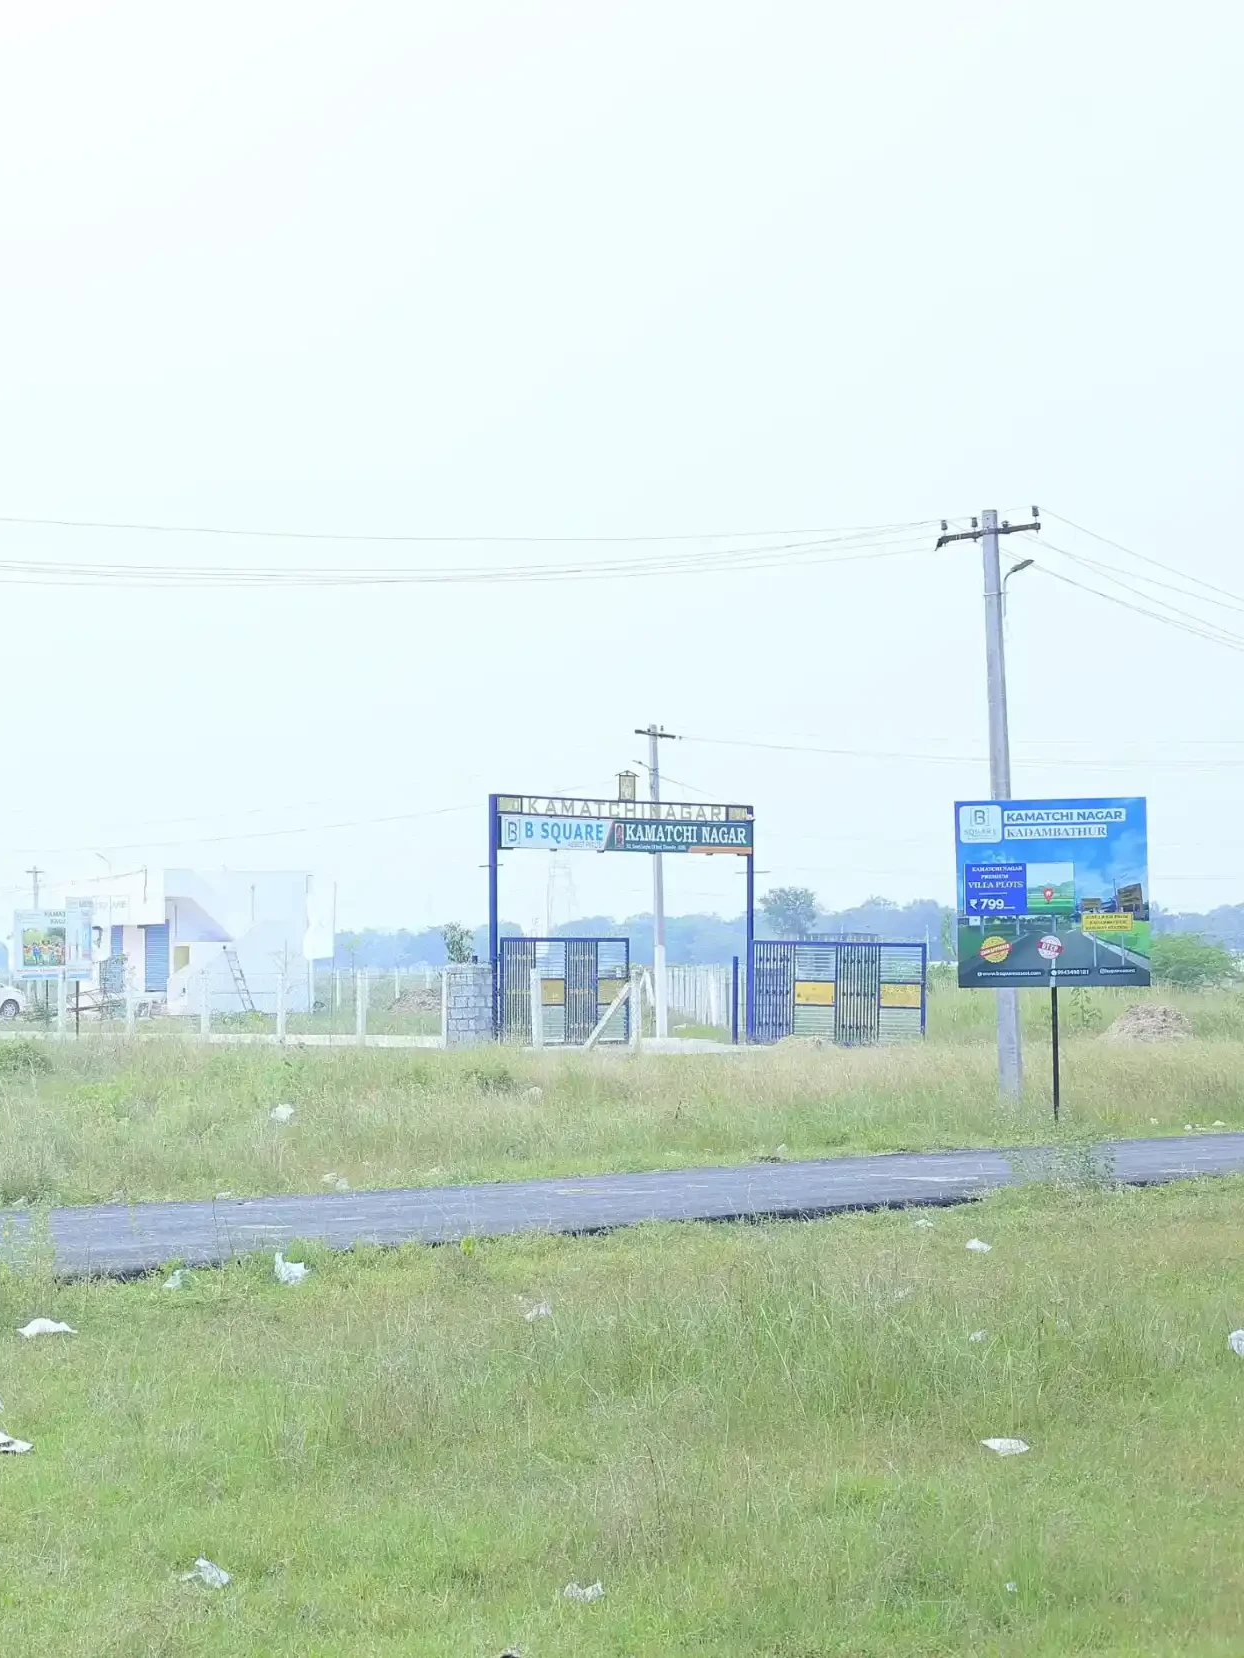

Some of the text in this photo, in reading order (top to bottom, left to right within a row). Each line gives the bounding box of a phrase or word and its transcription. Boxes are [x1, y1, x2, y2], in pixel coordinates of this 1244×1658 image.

[1006, 810, 1123, 823] KAMATCHI NAGAR
[524, 822, 604, 844] B SQUARE
[625, 823, 747, 844] KAMATCHI NAGAR
[1006, 826, 1107, 838] KADAMBATHUR
[968, 880, 1025, 889] VILLA PLOTS
[980, 898, 1005, 910] 799
